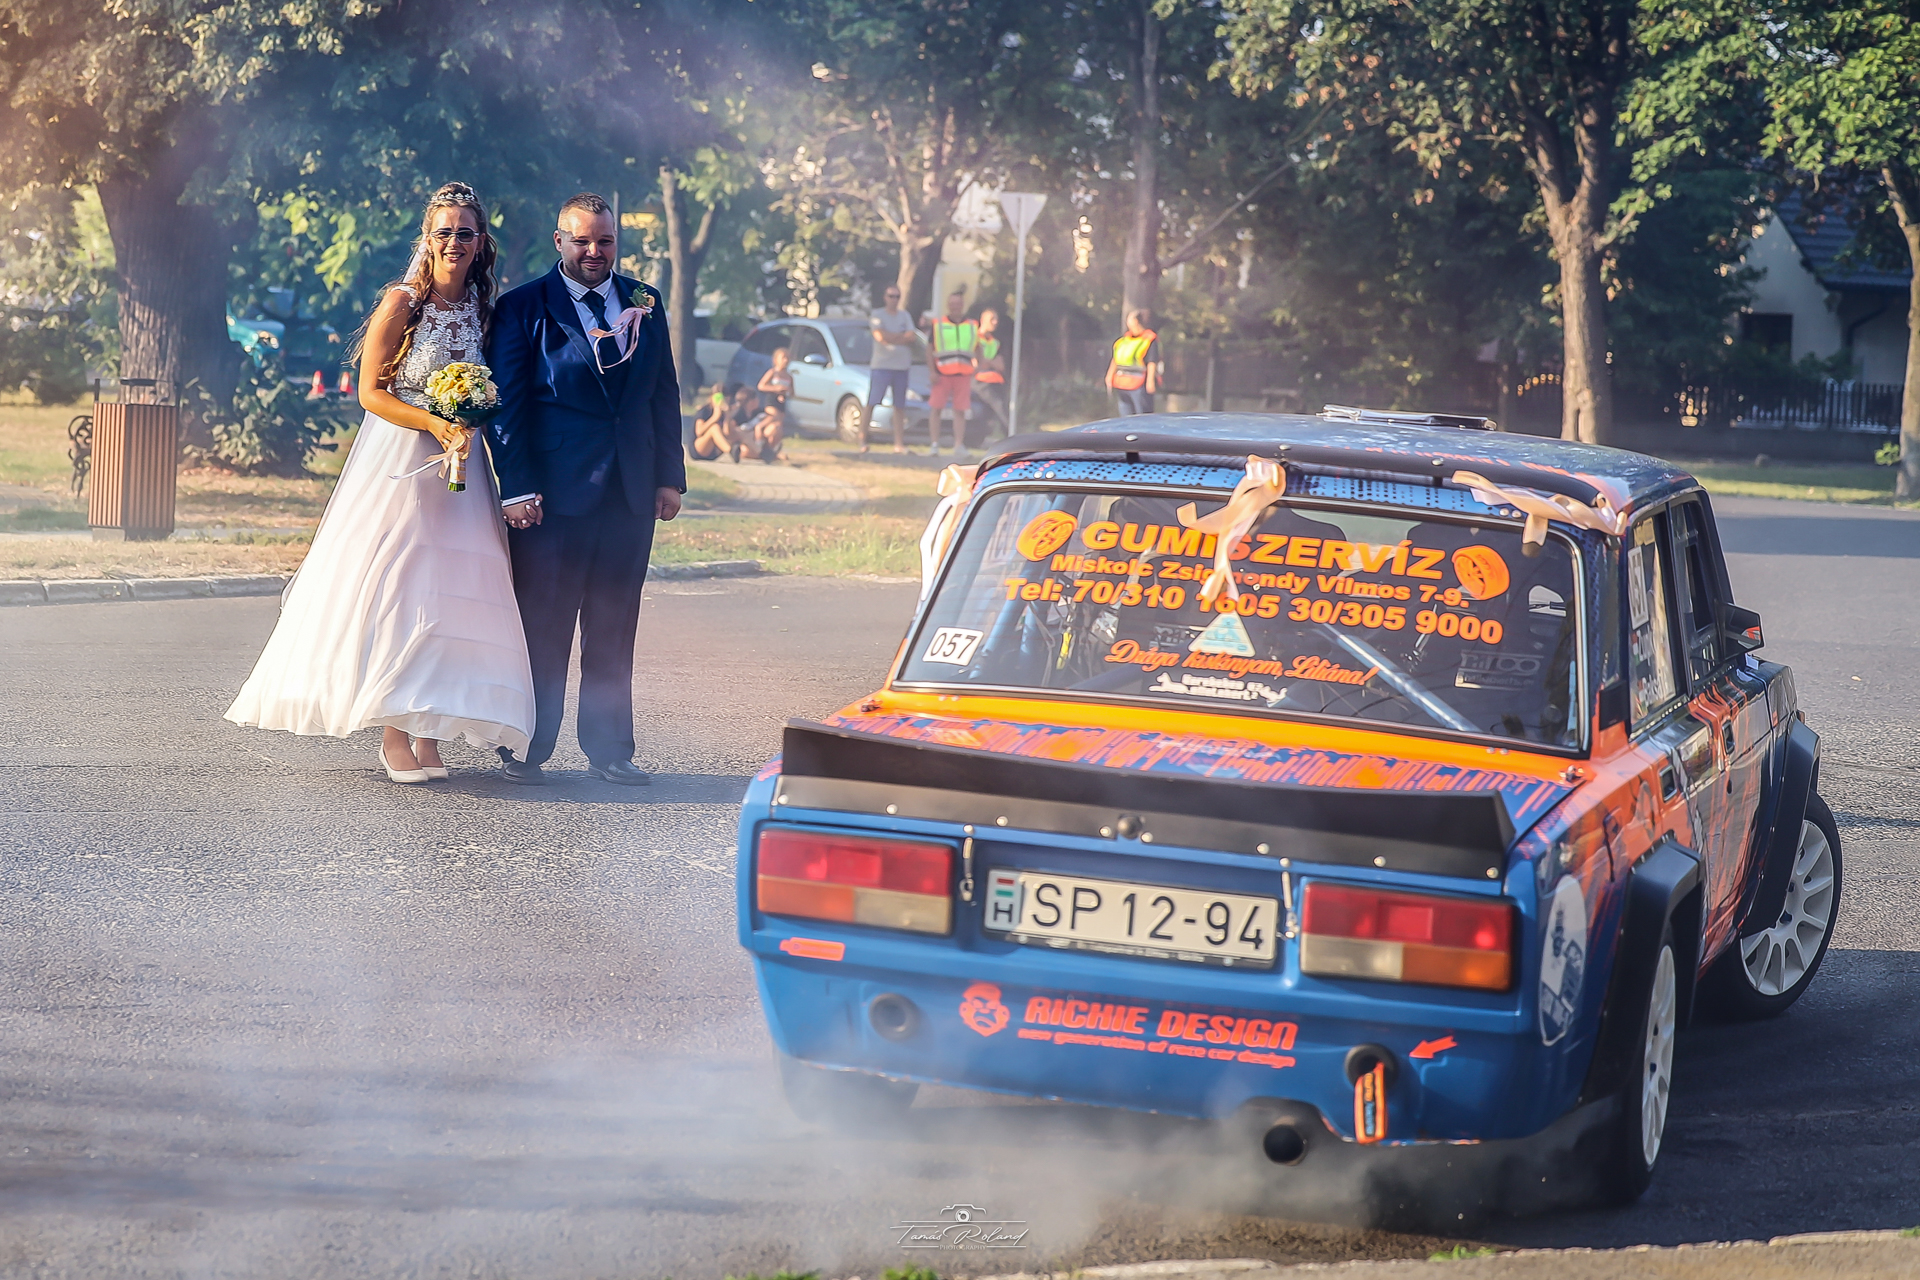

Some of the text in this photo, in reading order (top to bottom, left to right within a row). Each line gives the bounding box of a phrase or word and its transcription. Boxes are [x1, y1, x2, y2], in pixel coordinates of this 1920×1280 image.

[1051, 554, 1154, 577] Miskolc
[1316, 574, 1411, 600] Vilmos
[1419, 584, 1470, 608] 7-9.
[1004, 577, 1504, 645] Tel: 70/310 1605 30/305 9000
[930, 632, 978, 660] 057
[1104, 639, 1181, 672] Drága
[993, 902, 1014, 924] H
[1031, 883, 1102, 930] SP
[1122, 892, 1264, 950] 12-94
[1024, 996, 1299, 1050] RICHIE DESIGN
